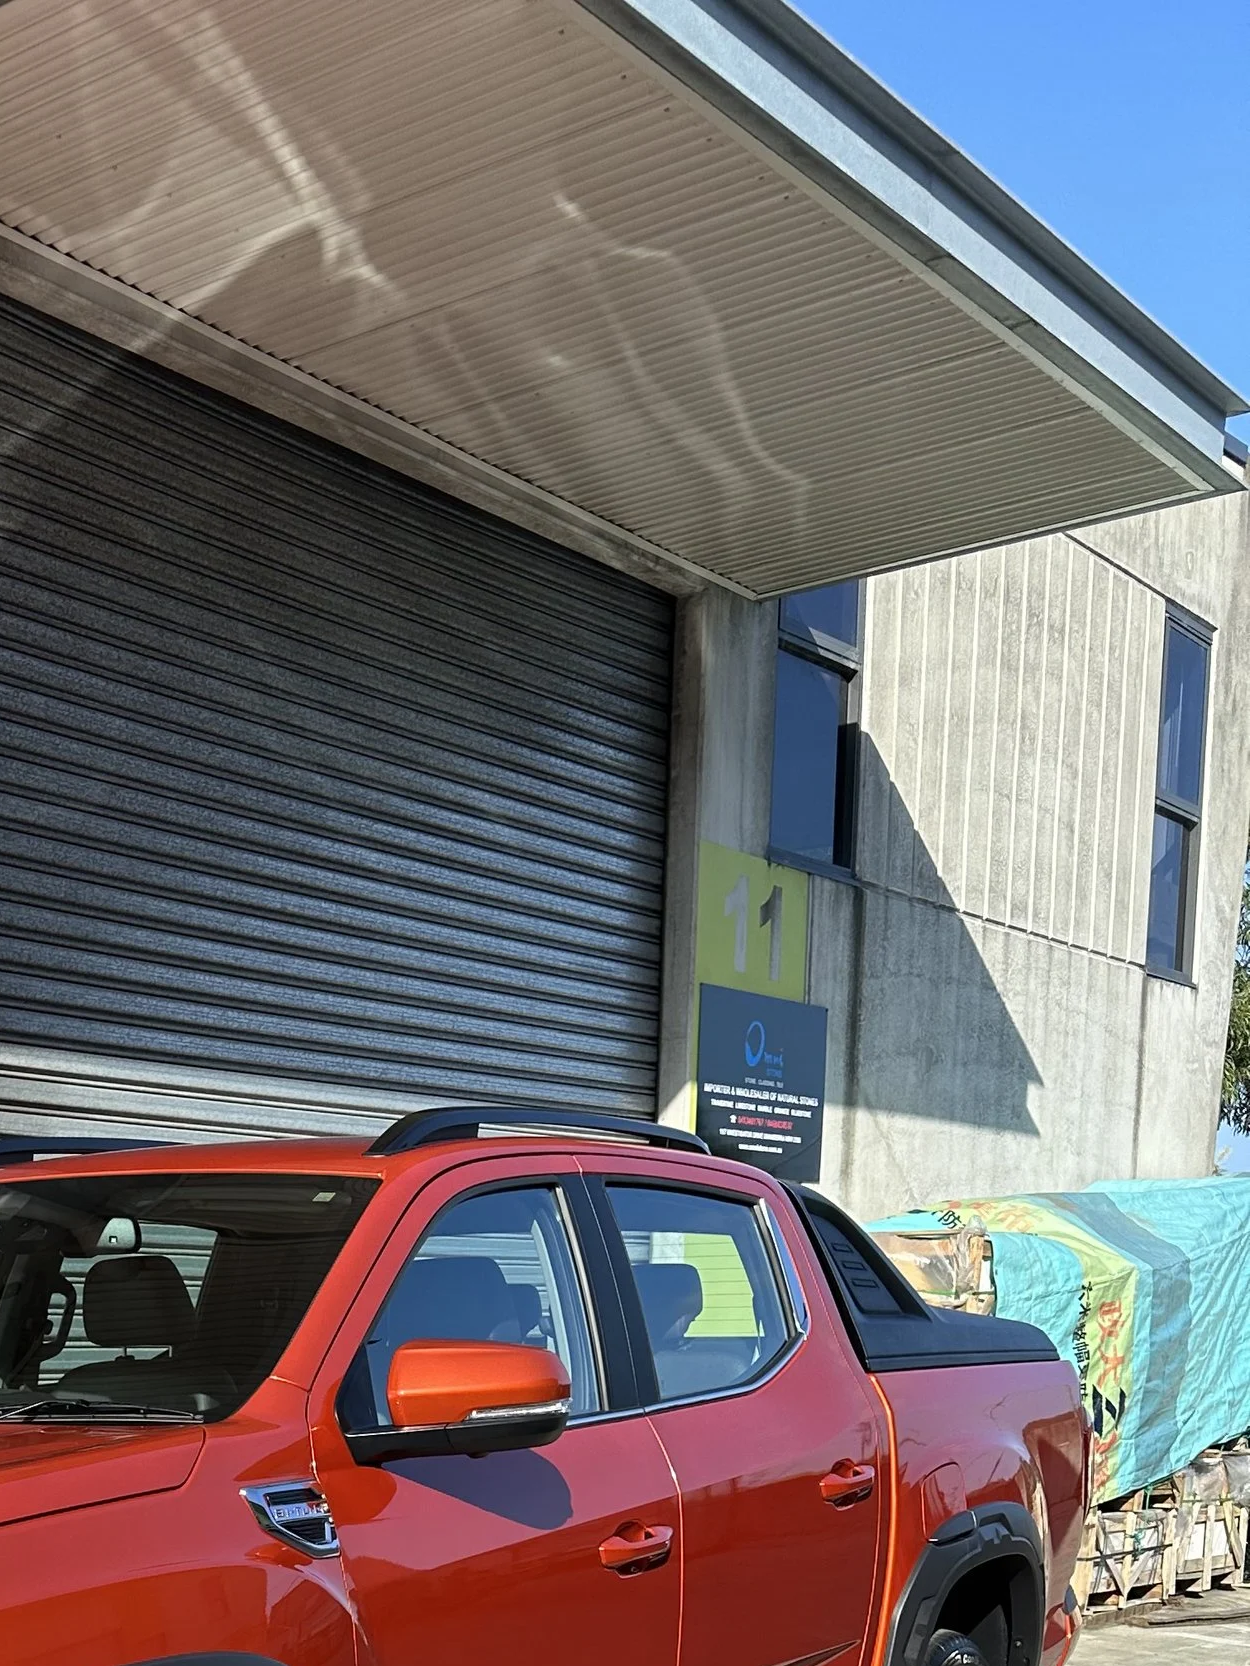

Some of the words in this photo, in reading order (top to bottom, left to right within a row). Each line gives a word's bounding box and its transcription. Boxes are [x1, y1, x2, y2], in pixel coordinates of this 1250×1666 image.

[724, 874, 783, 981] 11
[704, 1082, 731, 1095] IMPORTER
[736, 1087, 770, 1100] WHOLESALER
